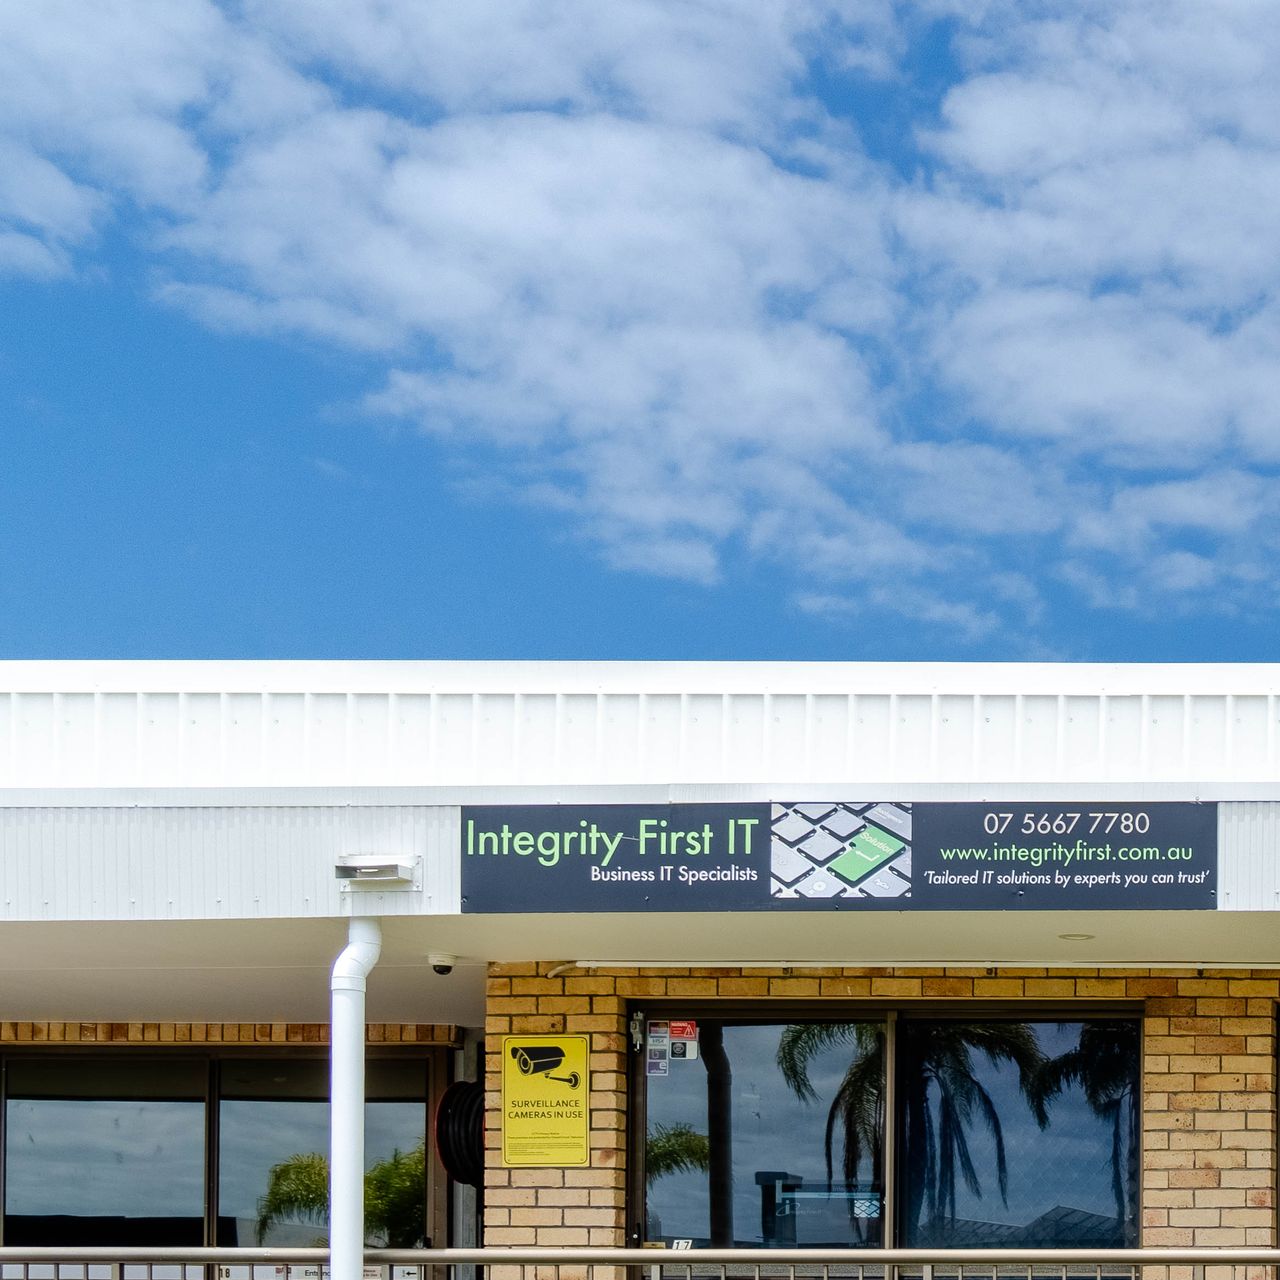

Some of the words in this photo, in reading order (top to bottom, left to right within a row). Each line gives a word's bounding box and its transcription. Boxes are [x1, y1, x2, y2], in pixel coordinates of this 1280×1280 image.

[984, 813, 1013, 834] 07
[1021, 813, 1081, 834] 5667
[1089, 813, 1150, 834] 7780
[467, 819, 624, 866] Integrity
[639, 819, 713, 855] First
[729, 819, 759, 854] IT
[861, 832, 894, 855] Solution
[940, 840, 1193, 866] www.integrityfirst.com.au
[591, 866, 655, 881] Business
[660, 866, 674, 881] IT
[679, 865, 758, 885] Specialists
[983, 871, 994, 884] IT
[997, 870, 1051, 884] solutions
[1055, 870, 1071, 888] by
[1074, 872, 1120, 887] experts
[1124, 874, 1147, 887] you
[1152, 874, 1174, 884] can
[508, 1111, 552, 1119] CAMERAS
